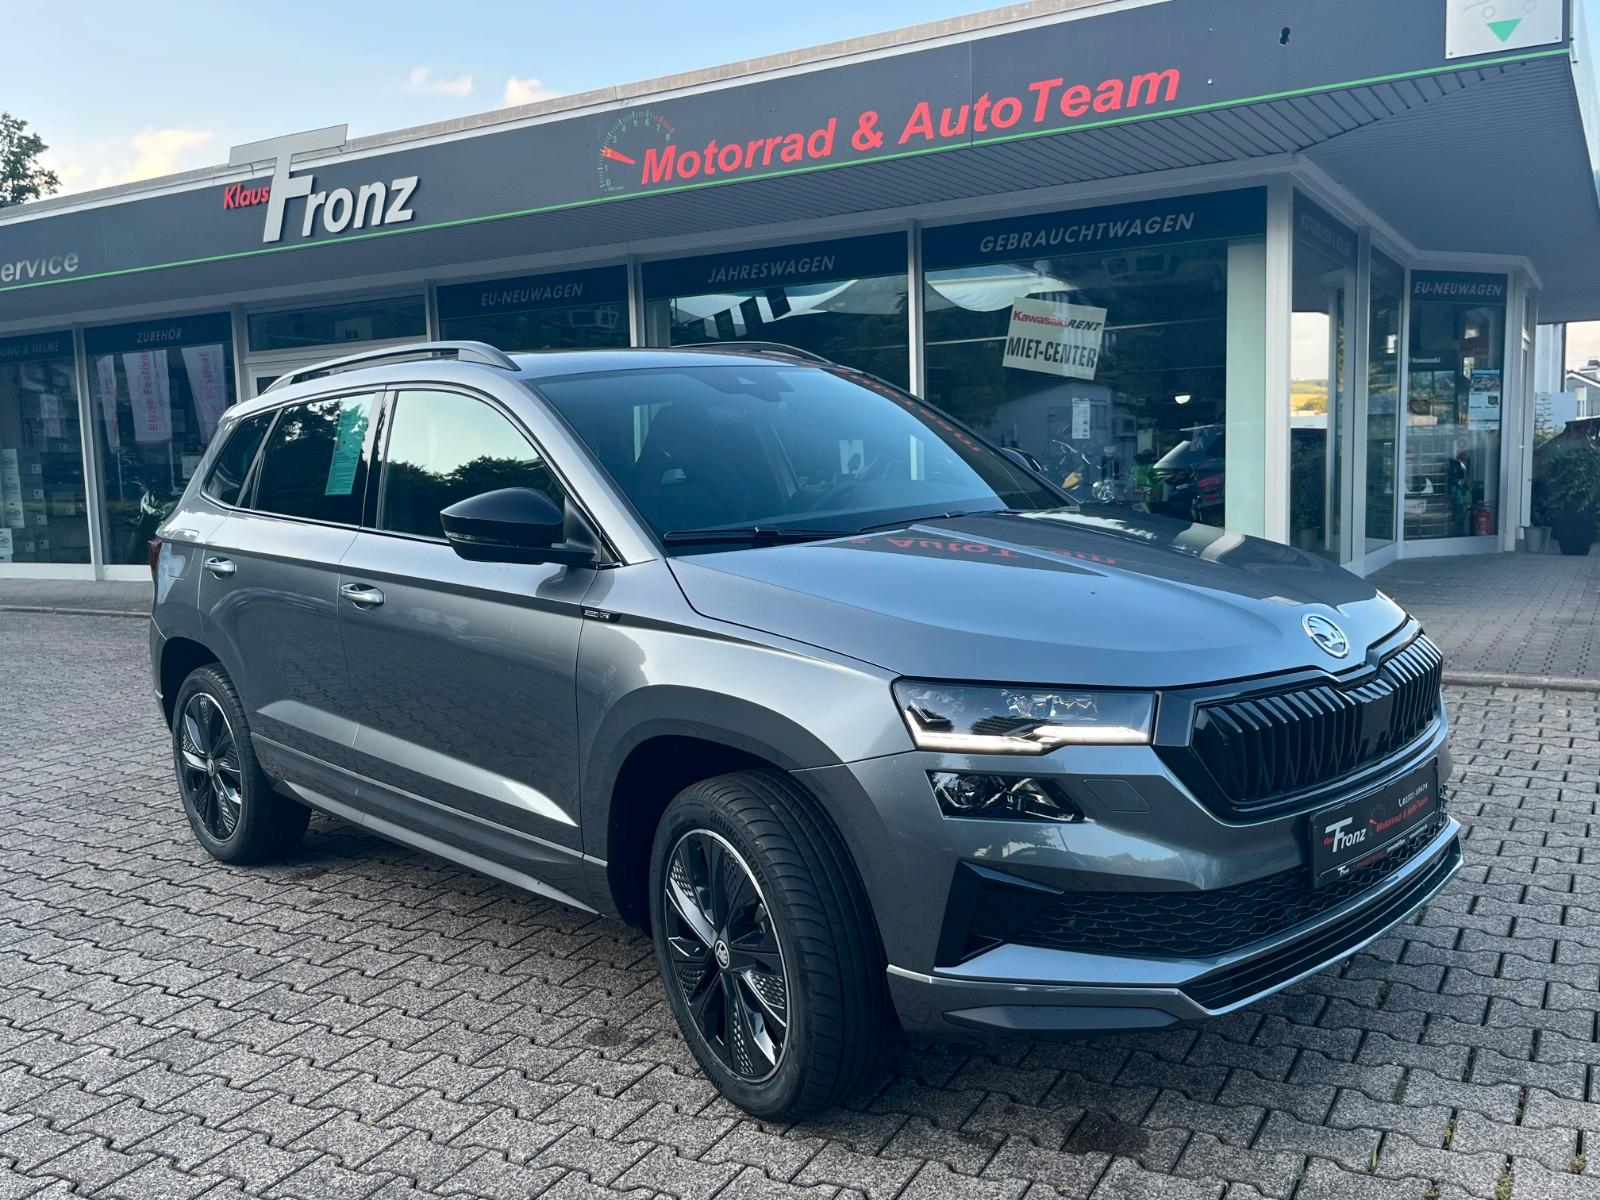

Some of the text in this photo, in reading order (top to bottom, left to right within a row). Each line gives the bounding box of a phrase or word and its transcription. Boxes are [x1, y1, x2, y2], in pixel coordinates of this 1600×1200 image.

[641, 117, 837, 185] Motorrad
[851, 110, 884, 152] &
[223, 123, 419, 243] Klaus Fronz
[980, 212, 1195, 253] GEBRAUCHTWAGEN
[707, 254, 836, 285] JAHRESWAGEN
[481, 283, 583, 306] EU-NEUWAGEN
[1414, 280, 1503, 297] EU-NEUWAGEN
[1006, 336, 1097, 369] MIET-CENTER
[1325, 816, 1367, 853] Fronz
